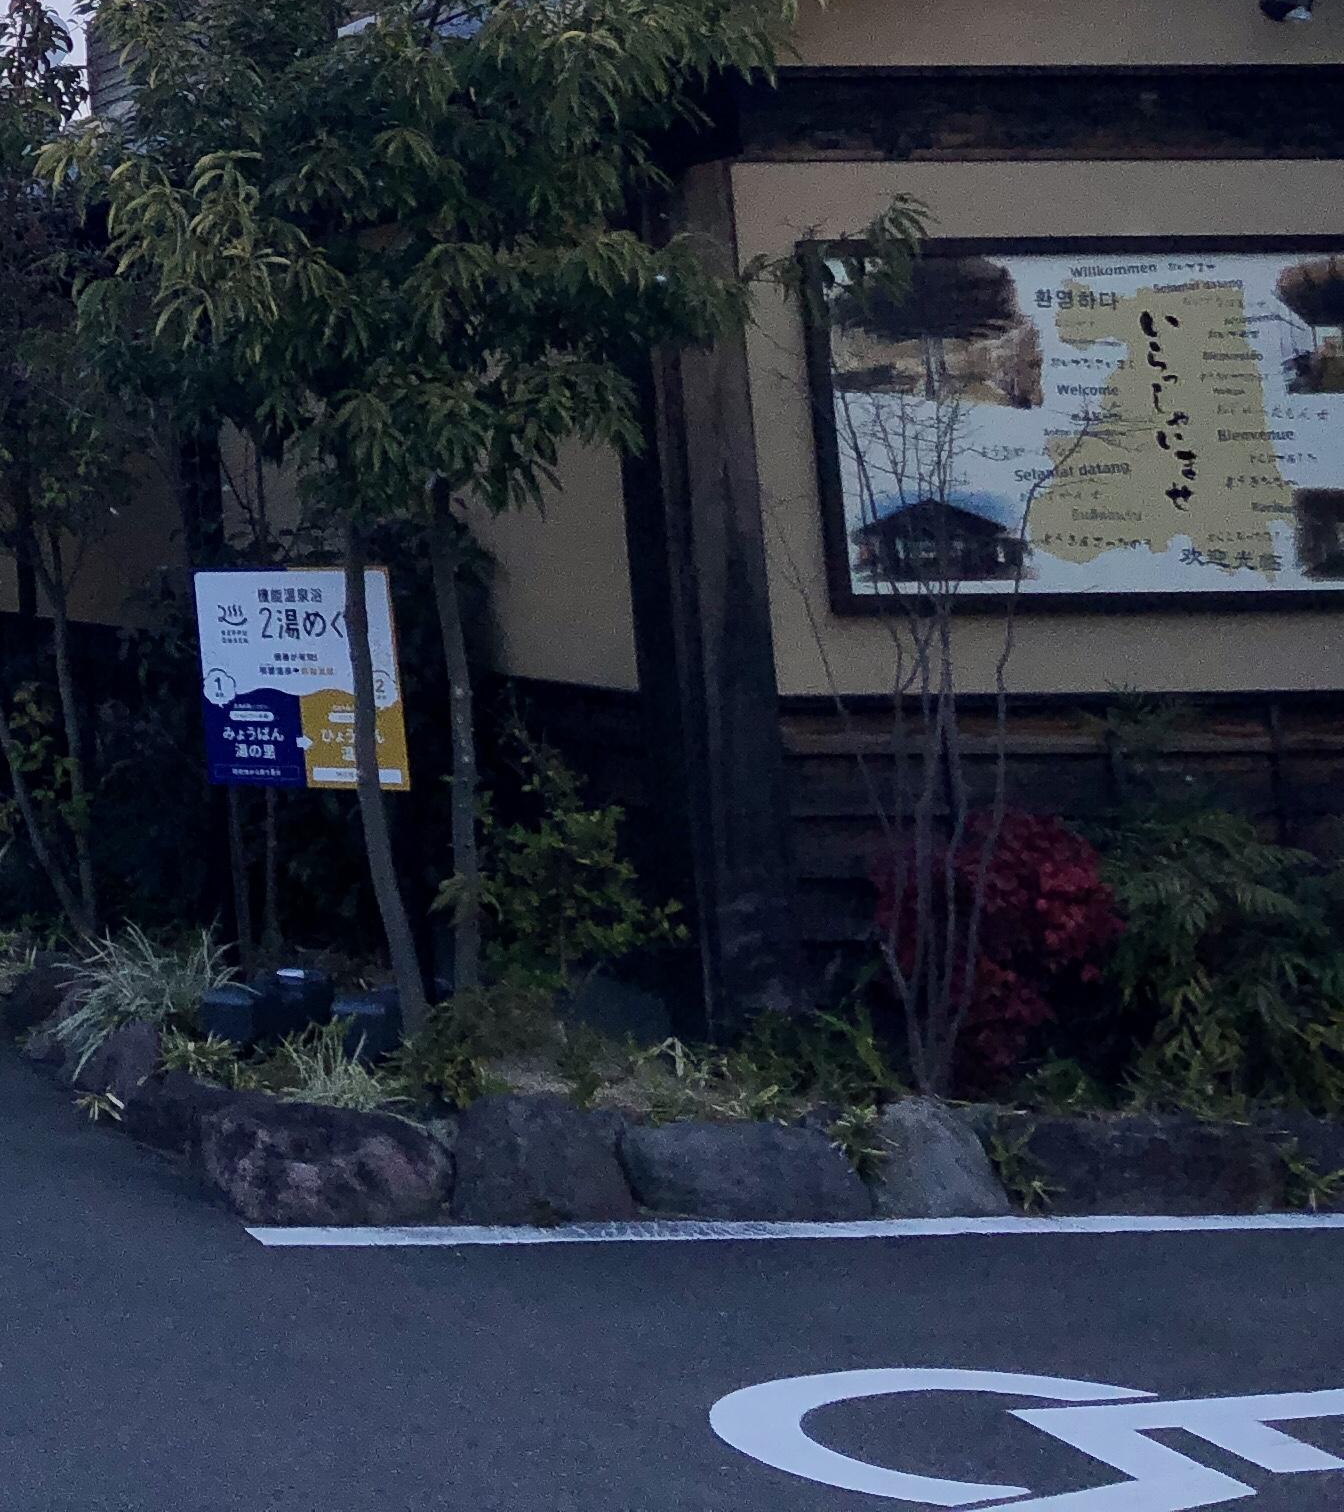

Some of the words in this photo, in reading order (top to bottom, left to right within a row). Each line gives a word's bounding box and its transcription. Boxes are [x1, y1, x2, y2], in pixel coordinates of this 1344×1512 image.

[1070, 263, 1158, 278] Willkommen
[1057, 383, 1119, 396] Welcome
[214, 677, 222, 691] 1
[375, 678, 385, 693] 2
[222, 726, 285, 742] みょうばん
[321, 728, 385, 744] ひょうん
